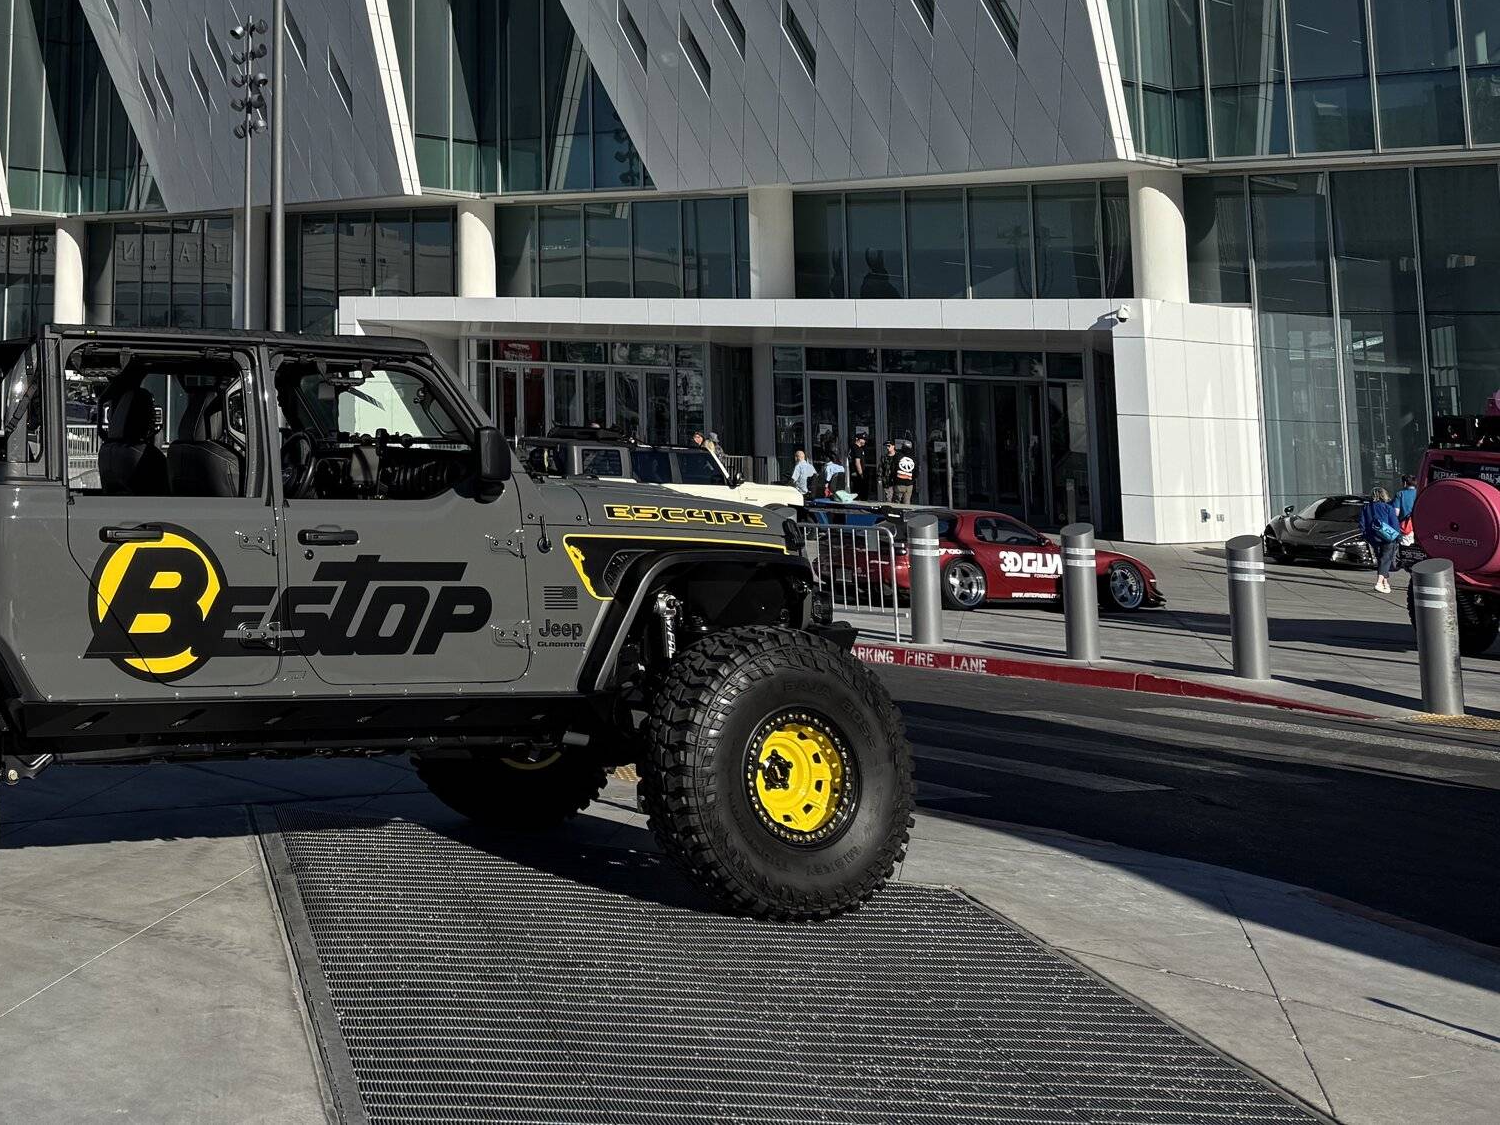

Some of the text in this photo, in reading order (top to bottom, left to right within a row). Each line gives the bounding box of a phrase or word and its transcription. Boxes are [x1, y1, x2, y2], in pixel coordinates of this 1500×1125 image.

[538, 619, 583, 640] Jeep
[850, 647, 988, 673] ARKING FIRE LANE
